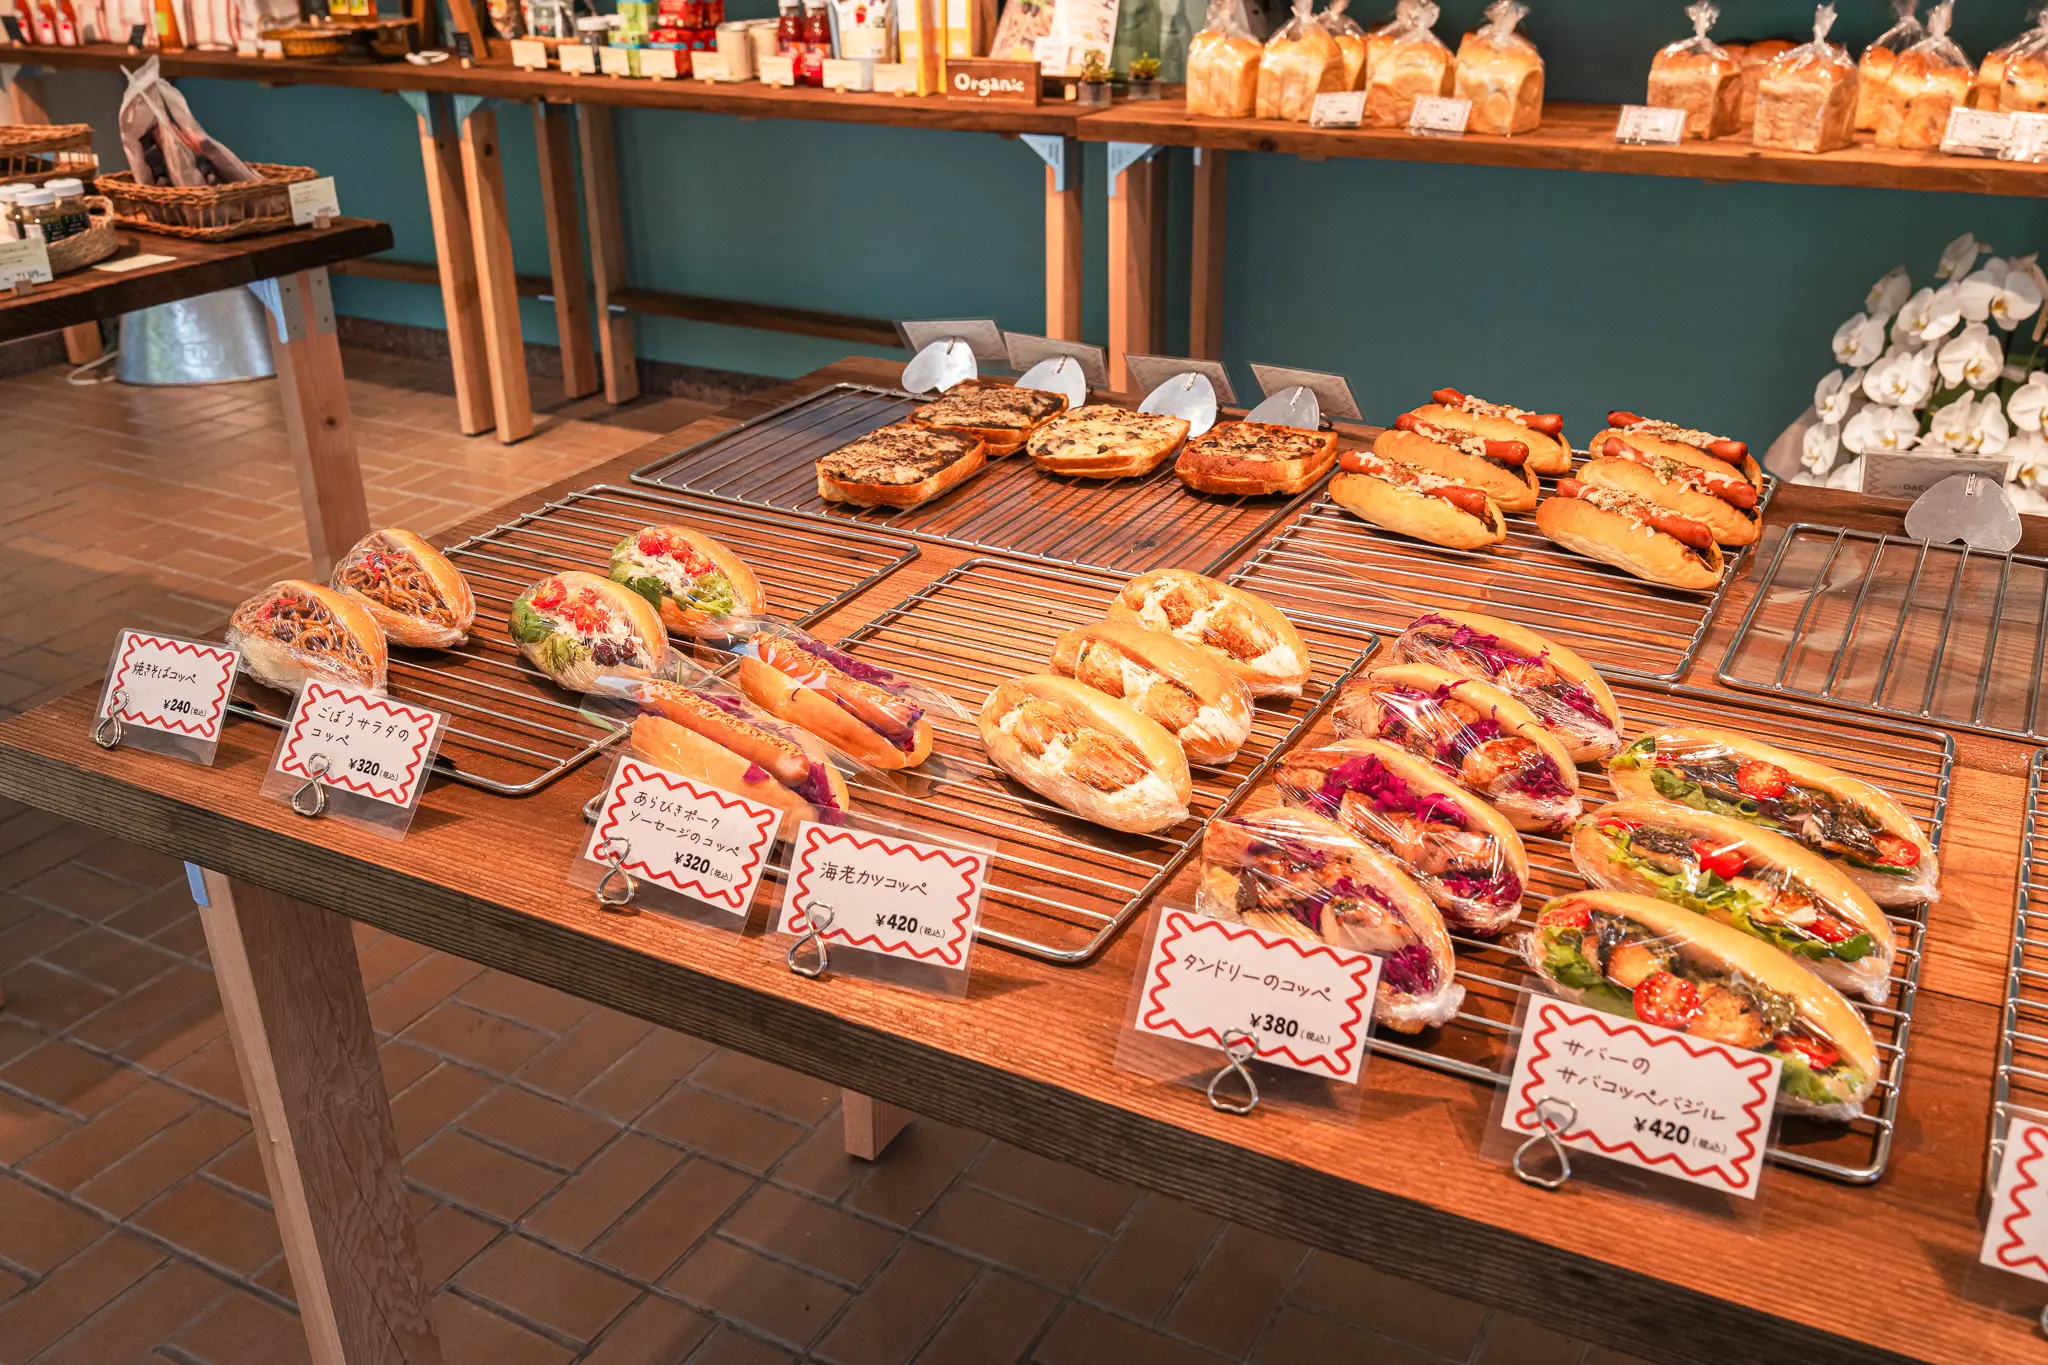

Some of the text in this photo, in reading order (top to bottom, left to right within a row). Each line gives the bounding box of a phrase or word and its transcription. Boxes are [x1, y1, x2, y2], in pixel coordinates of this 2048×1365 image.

[954, 73, 1025, 96] Organic
[132, 662, 196, 684] 焼きそばコッペ
[163, 698, 190, 714] ¥240
[311, 728, 349, 746] コッペ
[318, 706, 409, 742] ごぼうサラダの
[349, 758, 380, 776] ¥320
[634, 791, 720, 829] あらびきポーク
[629, 811, 740, 857] ソーセージのコッペ
[674, 852, 710, 873] ¥320
[820, 862, 927, 895] 海老カツコッペ
[876, 914, 918, 933] ¥420
[1184, 954, 1332, 1002] タンドリーのコッペ
[1249, 1013, 1299, 1037] ¥380
[1563, 1038, 1651, 1075] サバーの
[1556, 1066, 1726, 1121] サバコッペバジル
[1633, 1116, 1690, 1145] ¥420
